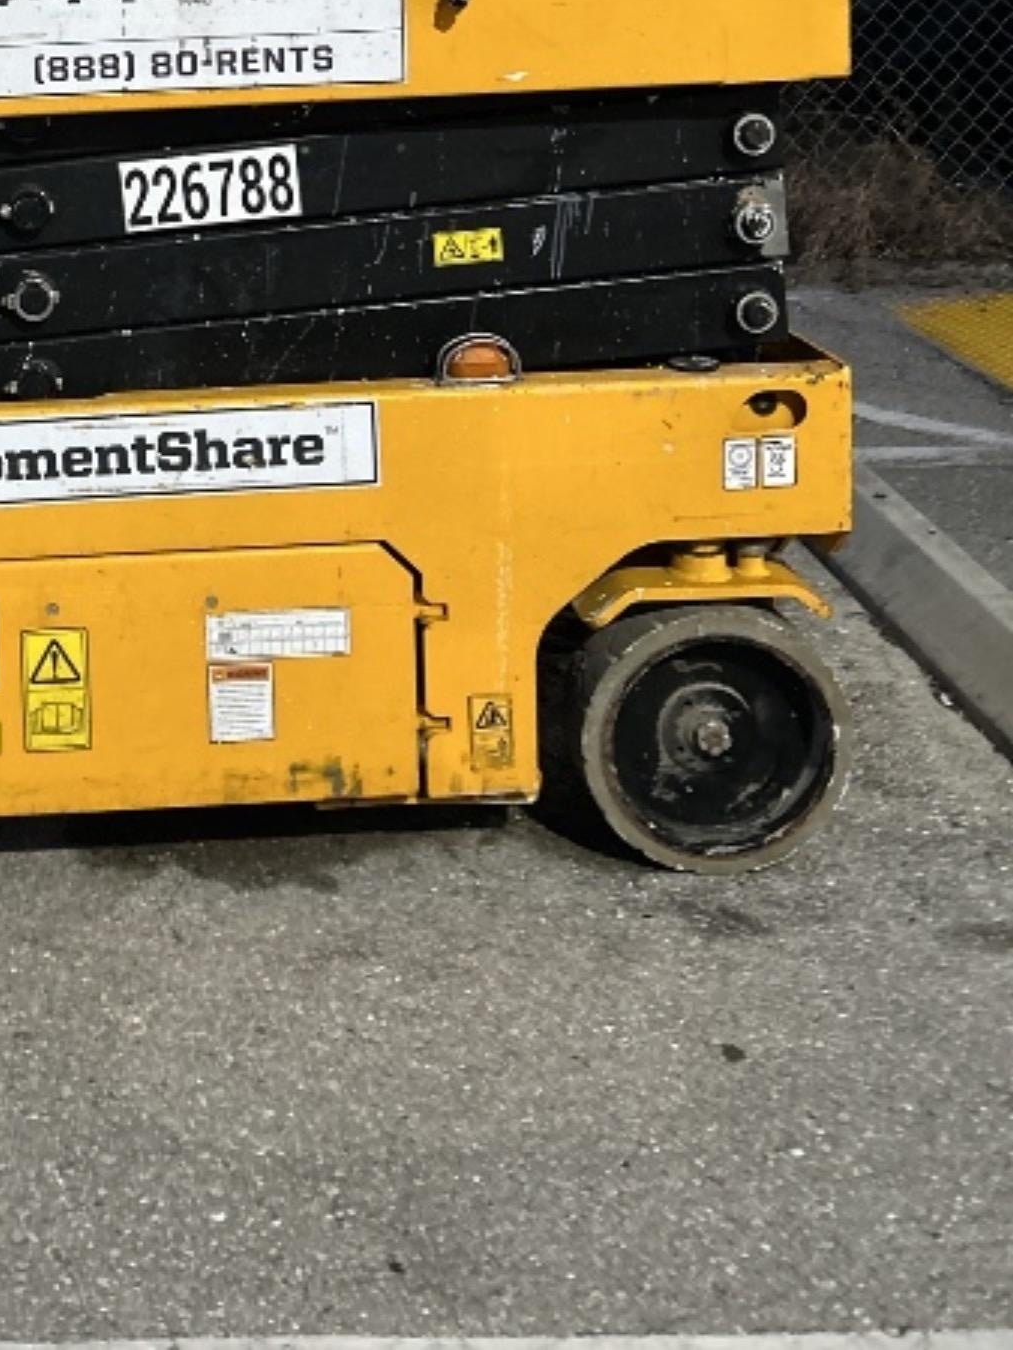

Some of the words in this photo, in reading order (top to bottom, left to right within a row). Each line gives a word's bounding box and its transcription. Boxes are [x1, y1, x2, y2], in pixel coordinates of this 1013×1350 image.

[34, 52, 135, 84] (888)
[151, 45, 335, 78] 80-RENTS
[124, 153, 295, 226] 226788
